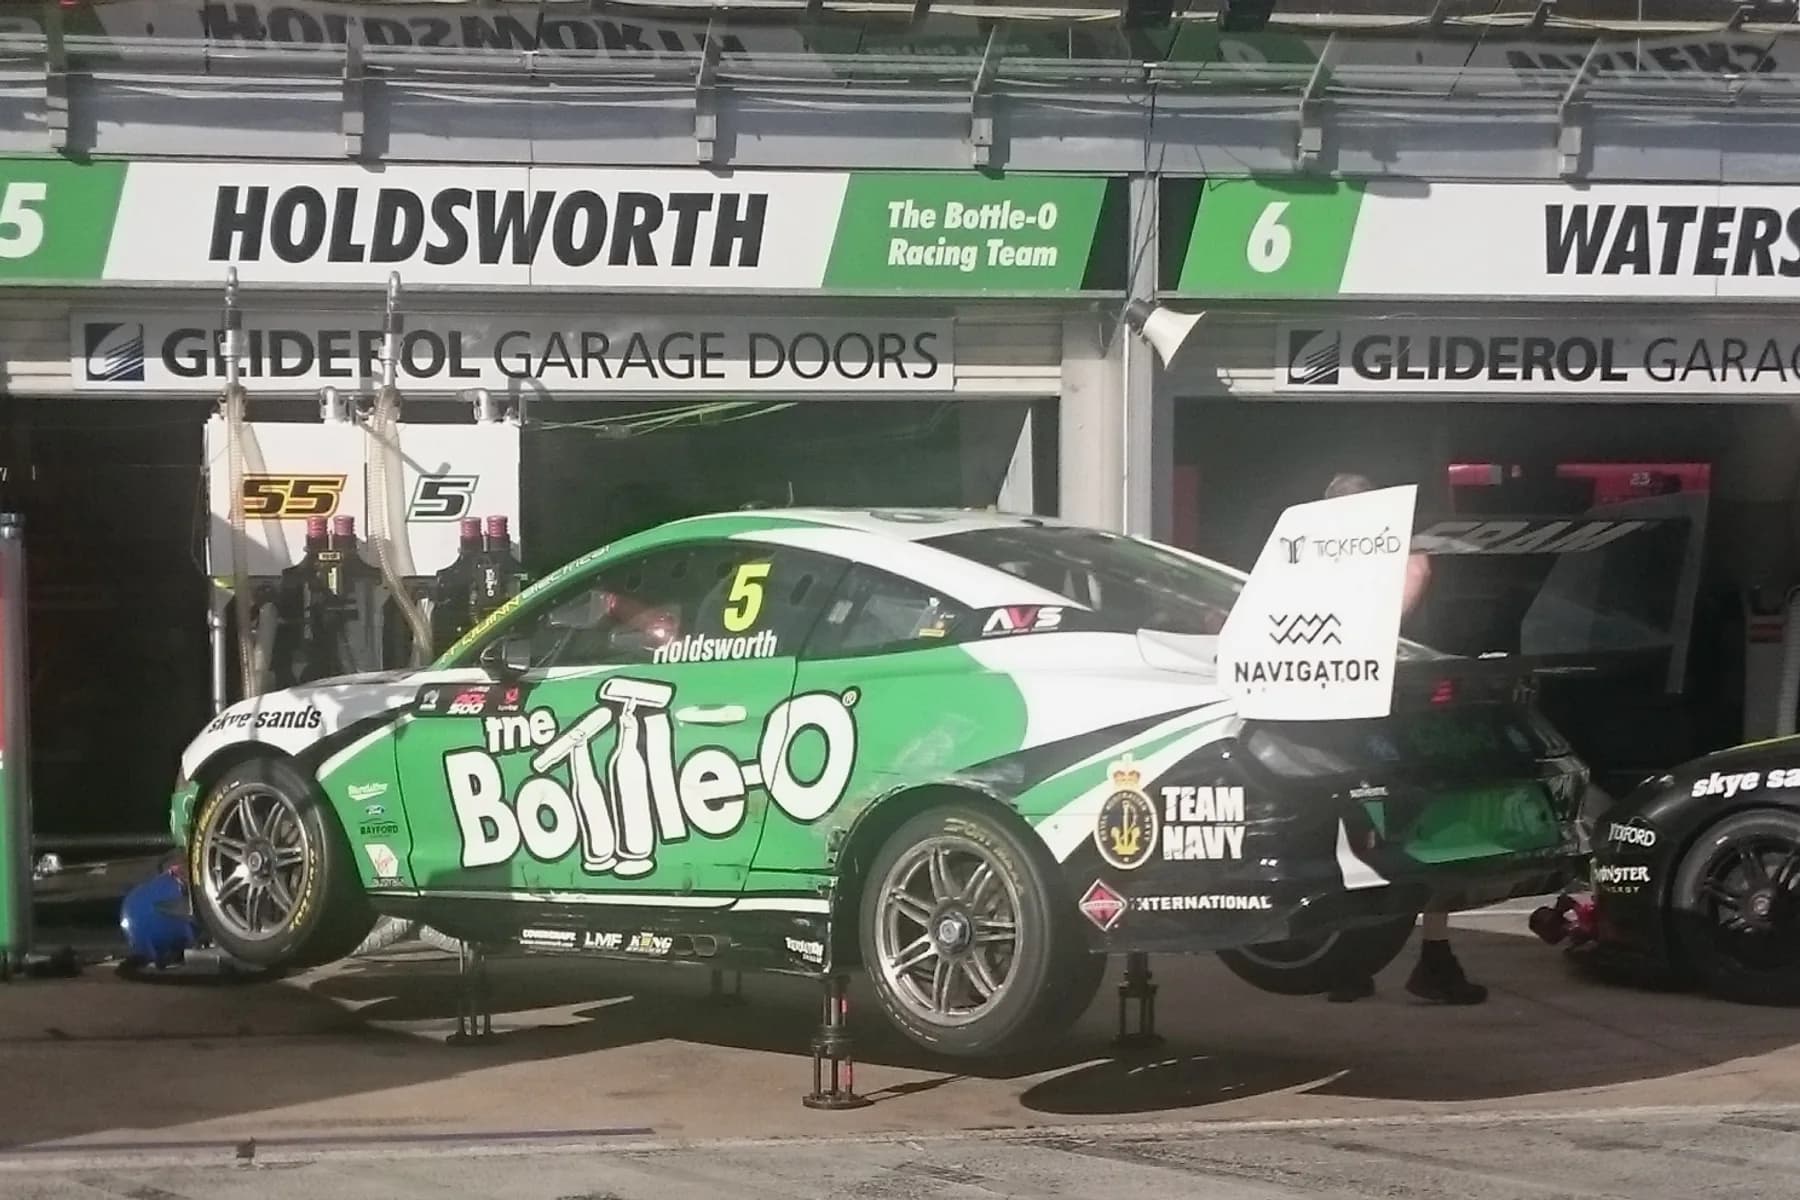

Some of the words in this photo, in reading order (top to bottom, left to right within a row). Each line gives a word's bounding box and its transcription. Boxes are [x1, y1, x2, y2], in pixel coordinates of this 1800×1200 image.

[0, 182, 47, 258] 5
[209, 185, 769, 267] HOLDSWORTH
[888, 200, 936, 228] The
[944, 200, 1057, 229] Bottle-O
[1246, 201, 1291, 273] 6
[888, 236, 978, 272] Racing
[987, 239, 1057, 266] Team
[494, 330, 726, 379] GARAGE
[748, 331, 938, 380] DOORS
[1352, 335, 1627, 382] GLIDEROL
[1643, 337, 1800, 383] GARA
[236, 474, 347, 519] 55
[405, 474, 480, 523] 5
[723, 563, 772, 632] 5
[1235, 659, 1380, 683] NAVIGATOR
[255, 705, 322, 729] sands
[1161, 786, 1245, 822] TEAM
[1691, 771, 1760, 798] skye
[1162, 825, 1245, 860] NAVY
